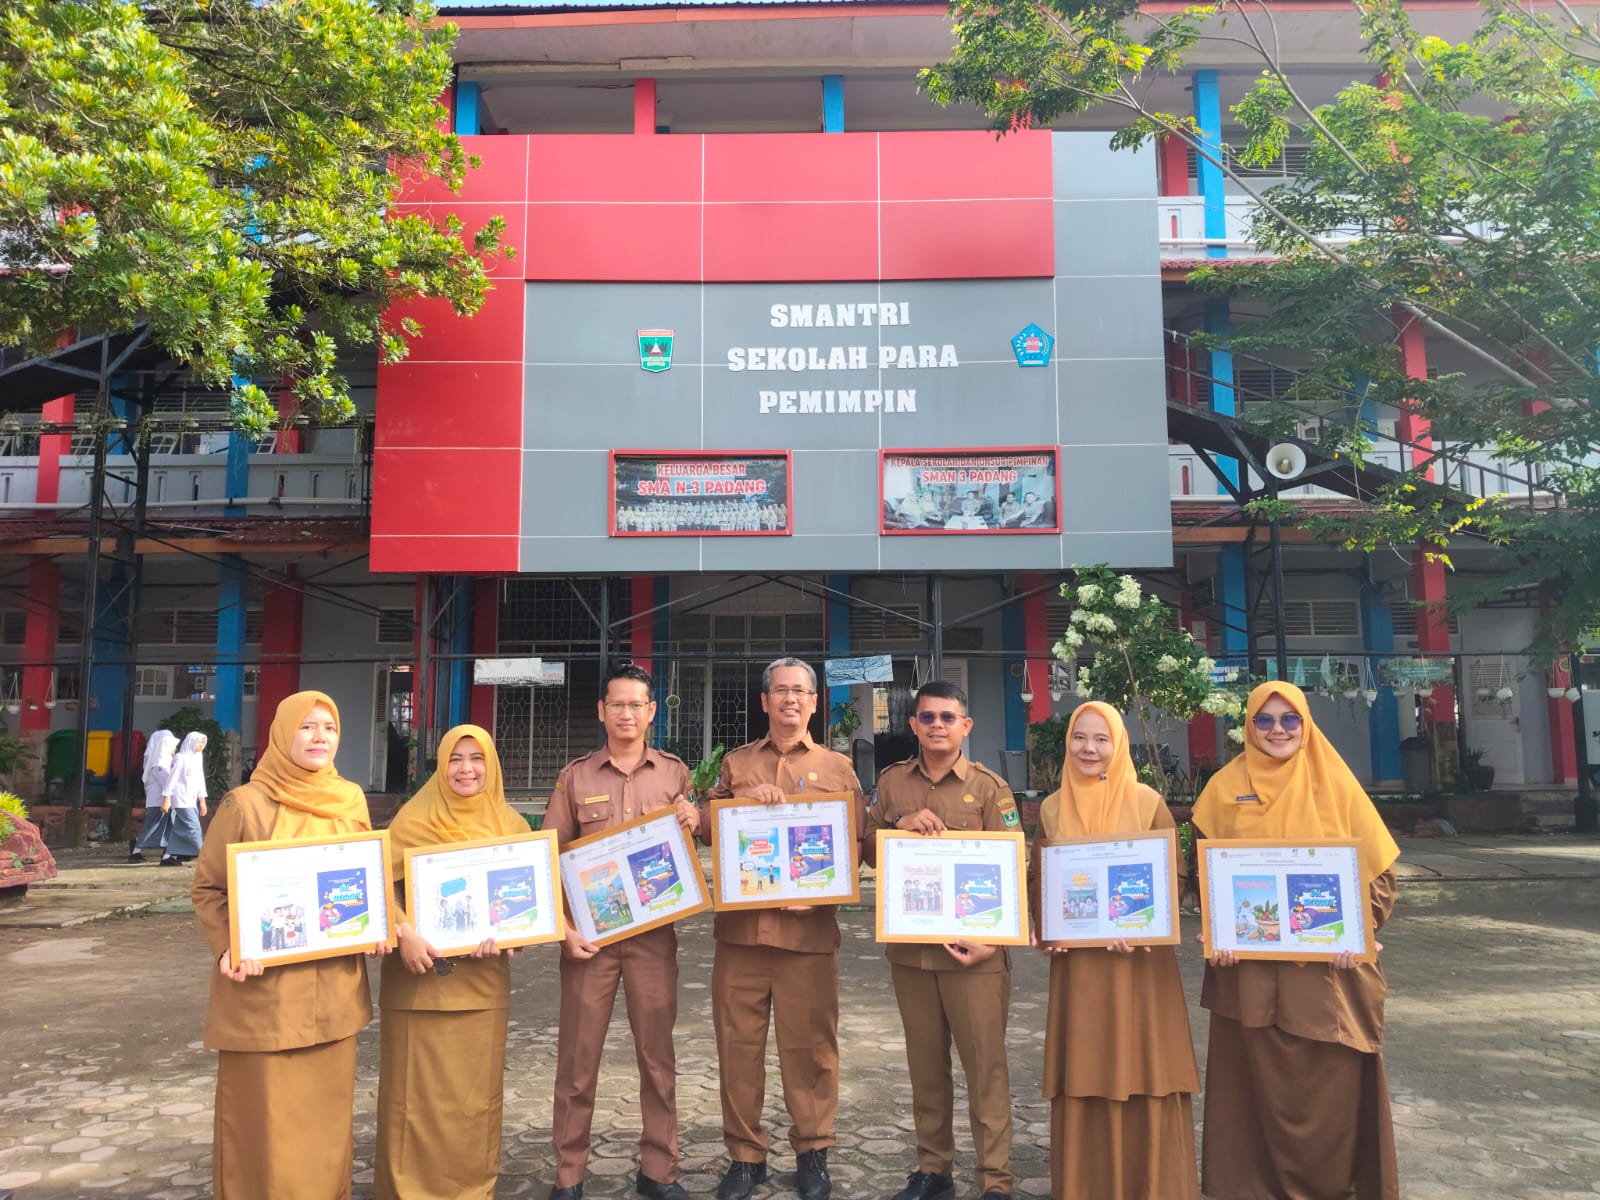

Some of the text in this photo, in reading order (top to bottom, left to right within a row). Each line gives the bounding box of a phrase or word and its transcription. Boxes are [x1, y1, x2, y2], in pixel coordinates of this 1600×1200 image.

[770, 302, 910, 327] SMANTRI
[727, 345, 959, 371] SEKOLAH PARA
[759, 390, 916, 414] PEMIMPIN
[657, 463, 746, 477] KELUARGA BESAR
[922, 470, 1017, 483] SMAN 3 PADANG
[637, 480, 671, 496] SMA
[704, 479, 767, 495] PADANG
